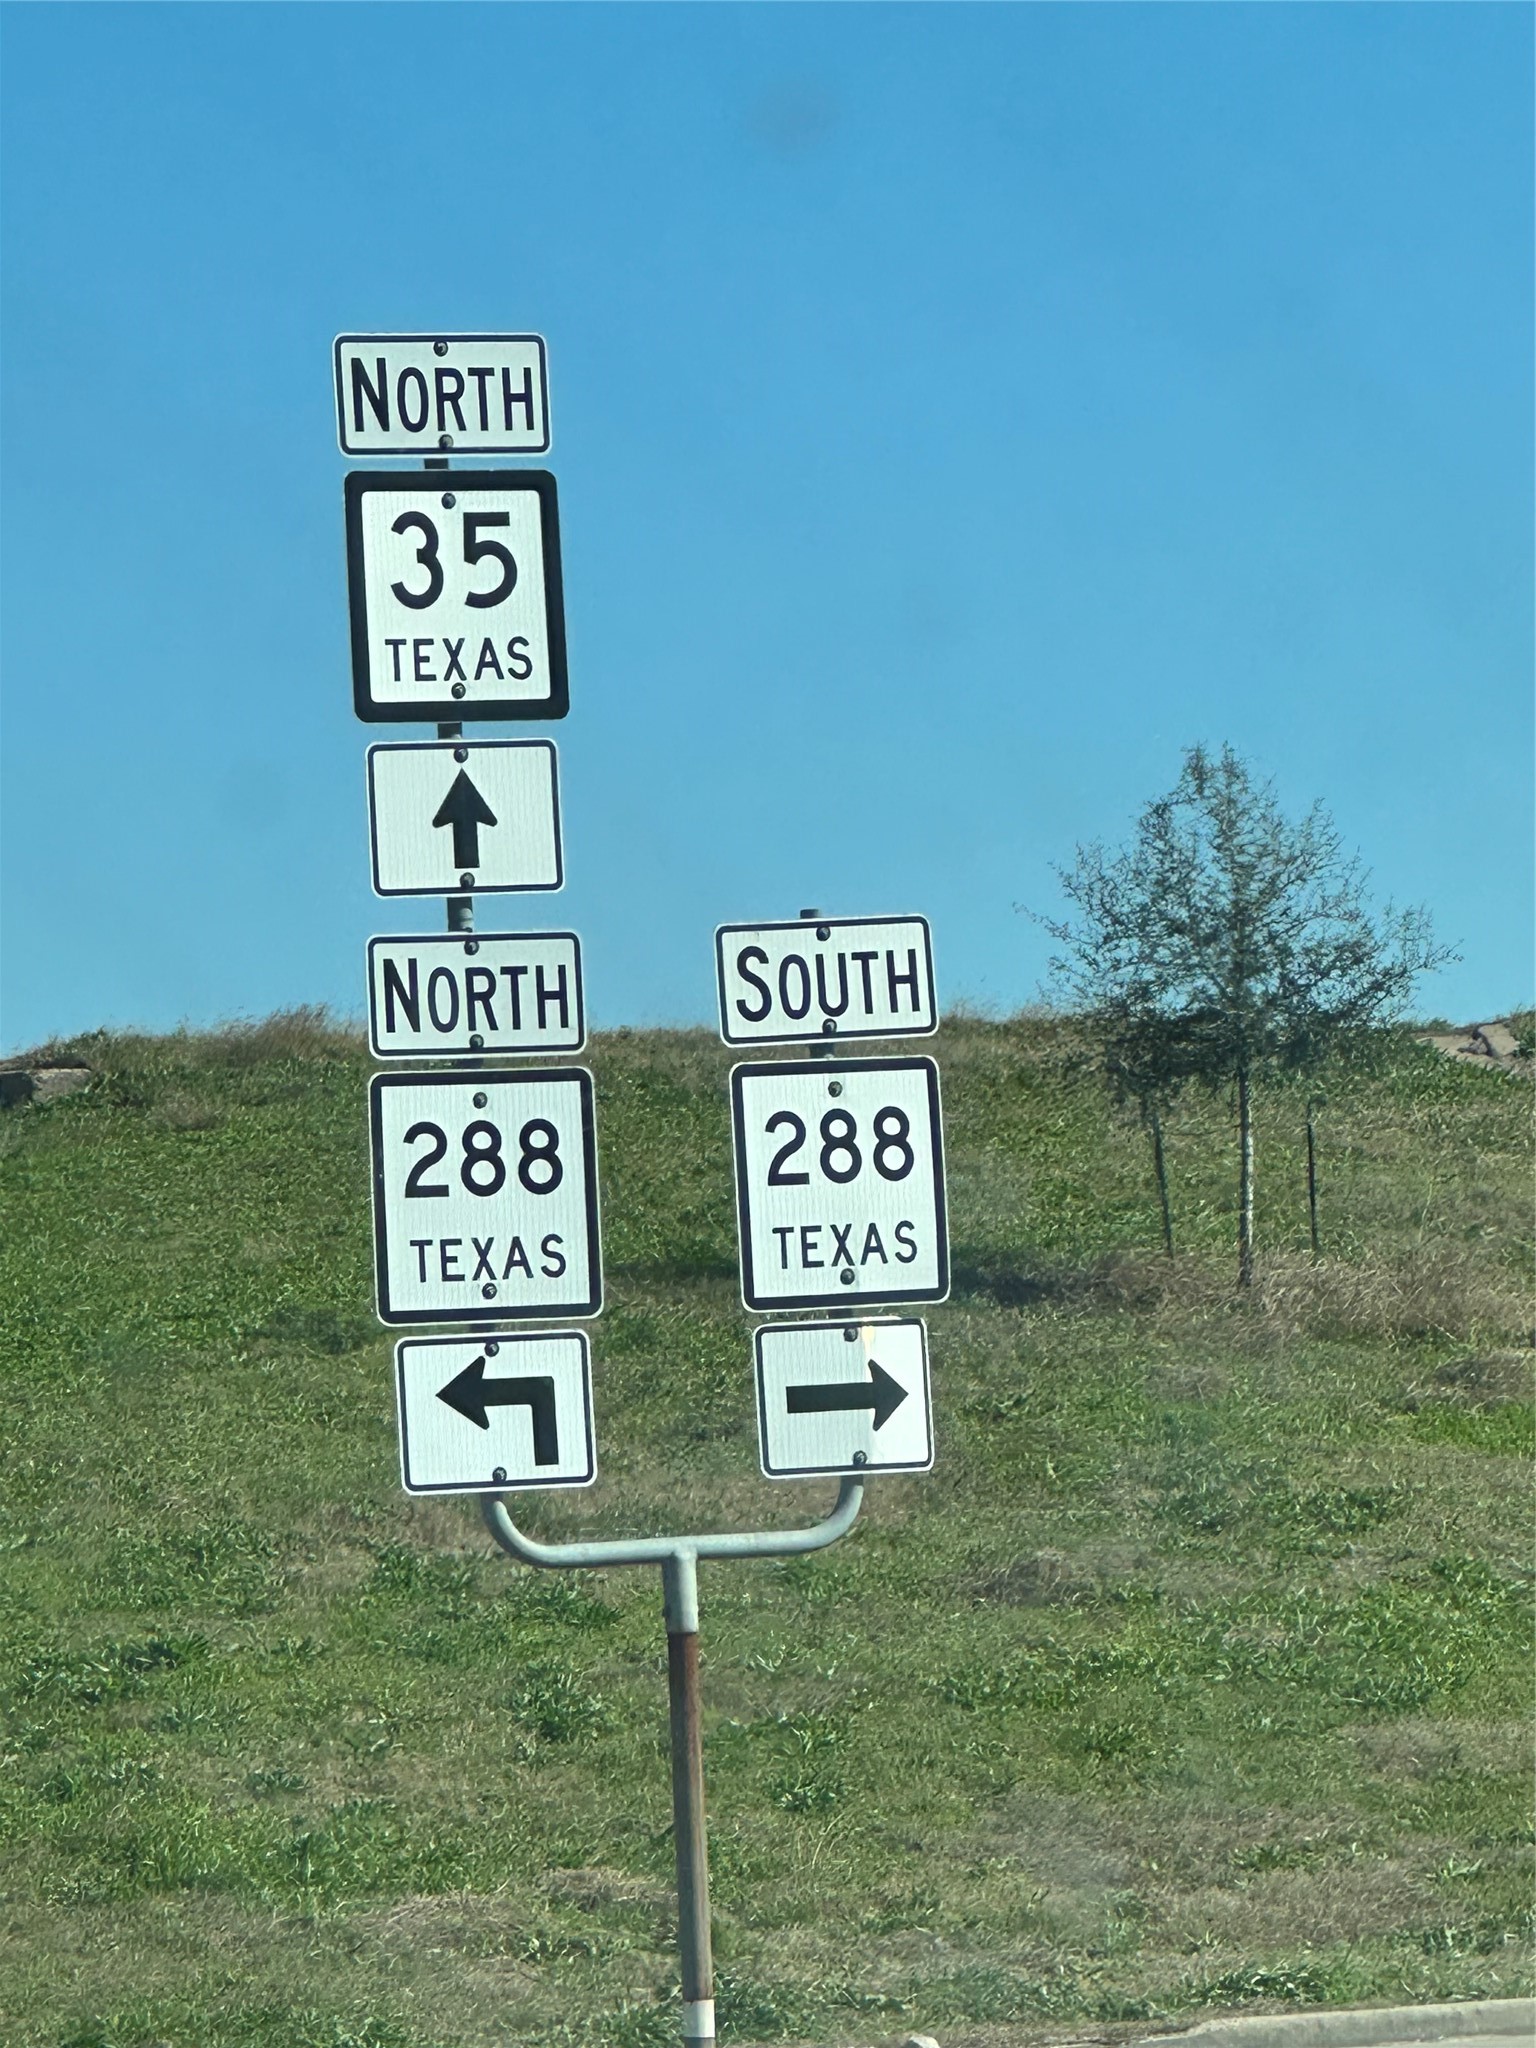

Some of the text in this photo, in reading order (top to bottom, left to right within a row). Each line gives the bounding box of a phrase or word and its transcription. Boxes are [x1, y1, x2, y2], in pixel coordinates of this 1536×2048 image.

[350, 357, 536, 433] NORTH
[390, 511, 518, 610] 35
[384, 636, 533, 682] TEXAS
[382, 957, 569, 1034] NORTH
[736, 945, 921, 1023] SOUTH
[403, 1118, 563, 1199] 288
[765, 1106, 915, 1187] 288
[409, 1233, 567, 1283] TEXAS
[771, 1220, 918, 1270] TEXAS
